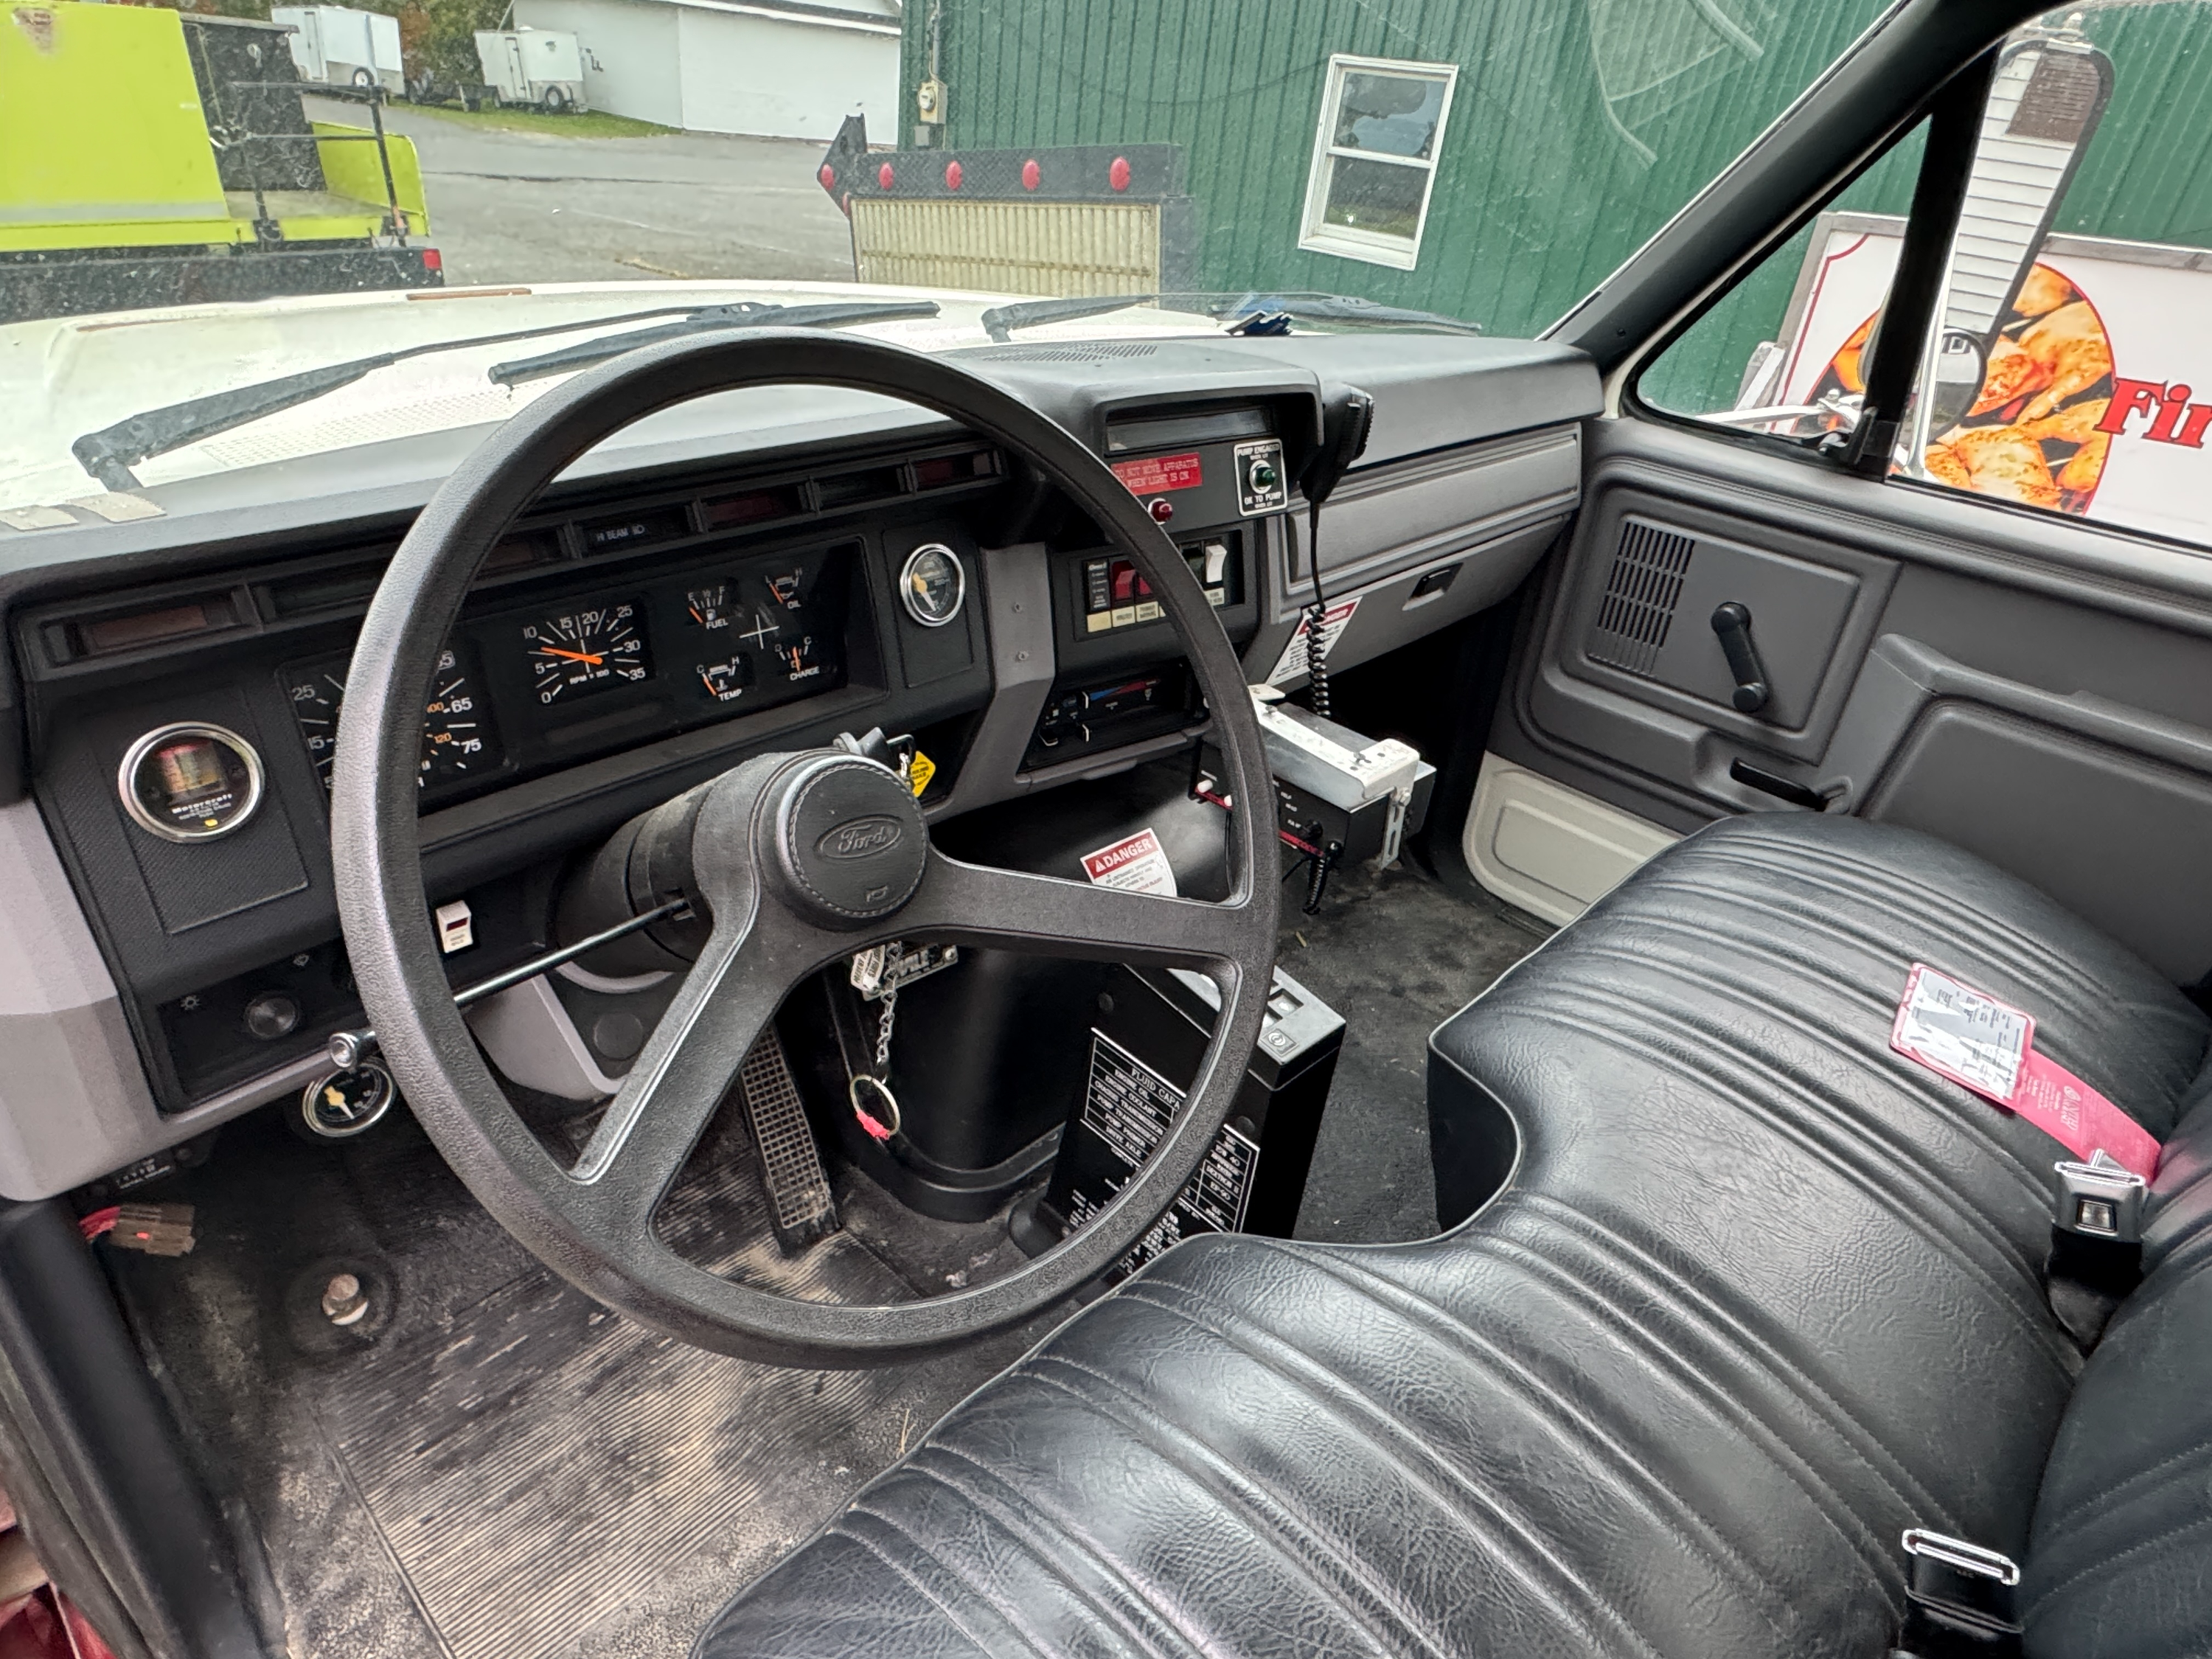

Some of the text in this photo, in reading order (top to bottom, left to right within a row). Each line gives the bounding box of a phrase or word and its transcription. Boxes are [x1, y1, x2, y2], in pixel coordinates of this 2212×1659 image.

[607, 527, 629, 540] BEAM
[787, 599, 801, 610] OIL
[582, 611, 599, 625] 20
[616, 605, 633, 619] 25
[560, 616, 573, 630] 15
[706, 618, 728, 630] FUEL
[523, 626, 538, 639] 10
[624, 639, 641, 653] 30
[731, 656, 740, 665] H
[535, 662, 545, 675] 5
[629, 667, 646, 681] 35
[697, 664, 705, 674] C
[790, 666, 820, 681] CHARGE
[292, 684, 316, 700] 25
[540, 692, 552, 703] 0
[718, 689, 743, 702] TEMP
[451, 697, 473, 713] 65
[307, 735, 325, 750] 15
[434, 732, 451, 744] 120
[461, 738, 481, 754] 75
[838, 823, 888, 854] Ford
[1102, 838, 1152, 868] DANGER
[1114, 1068, 1150, 1100] ENGINE OIL
[1131, 1068, 1157, 1091] FLUID
[1105, 1074, 1158, 1118] ENGINE COOLANT
[1096, 1094, 1158, 1144] PUMP TRANSMISSION
[1120, 1099, 1164, 1136] TRANSMISSION
[1105, 1112, 1146, 1149] PUMP PRIMER
[1105, 1125, 1124, 1144] DRIVE
[1125, 1141, 1143, 1158] AXLE
